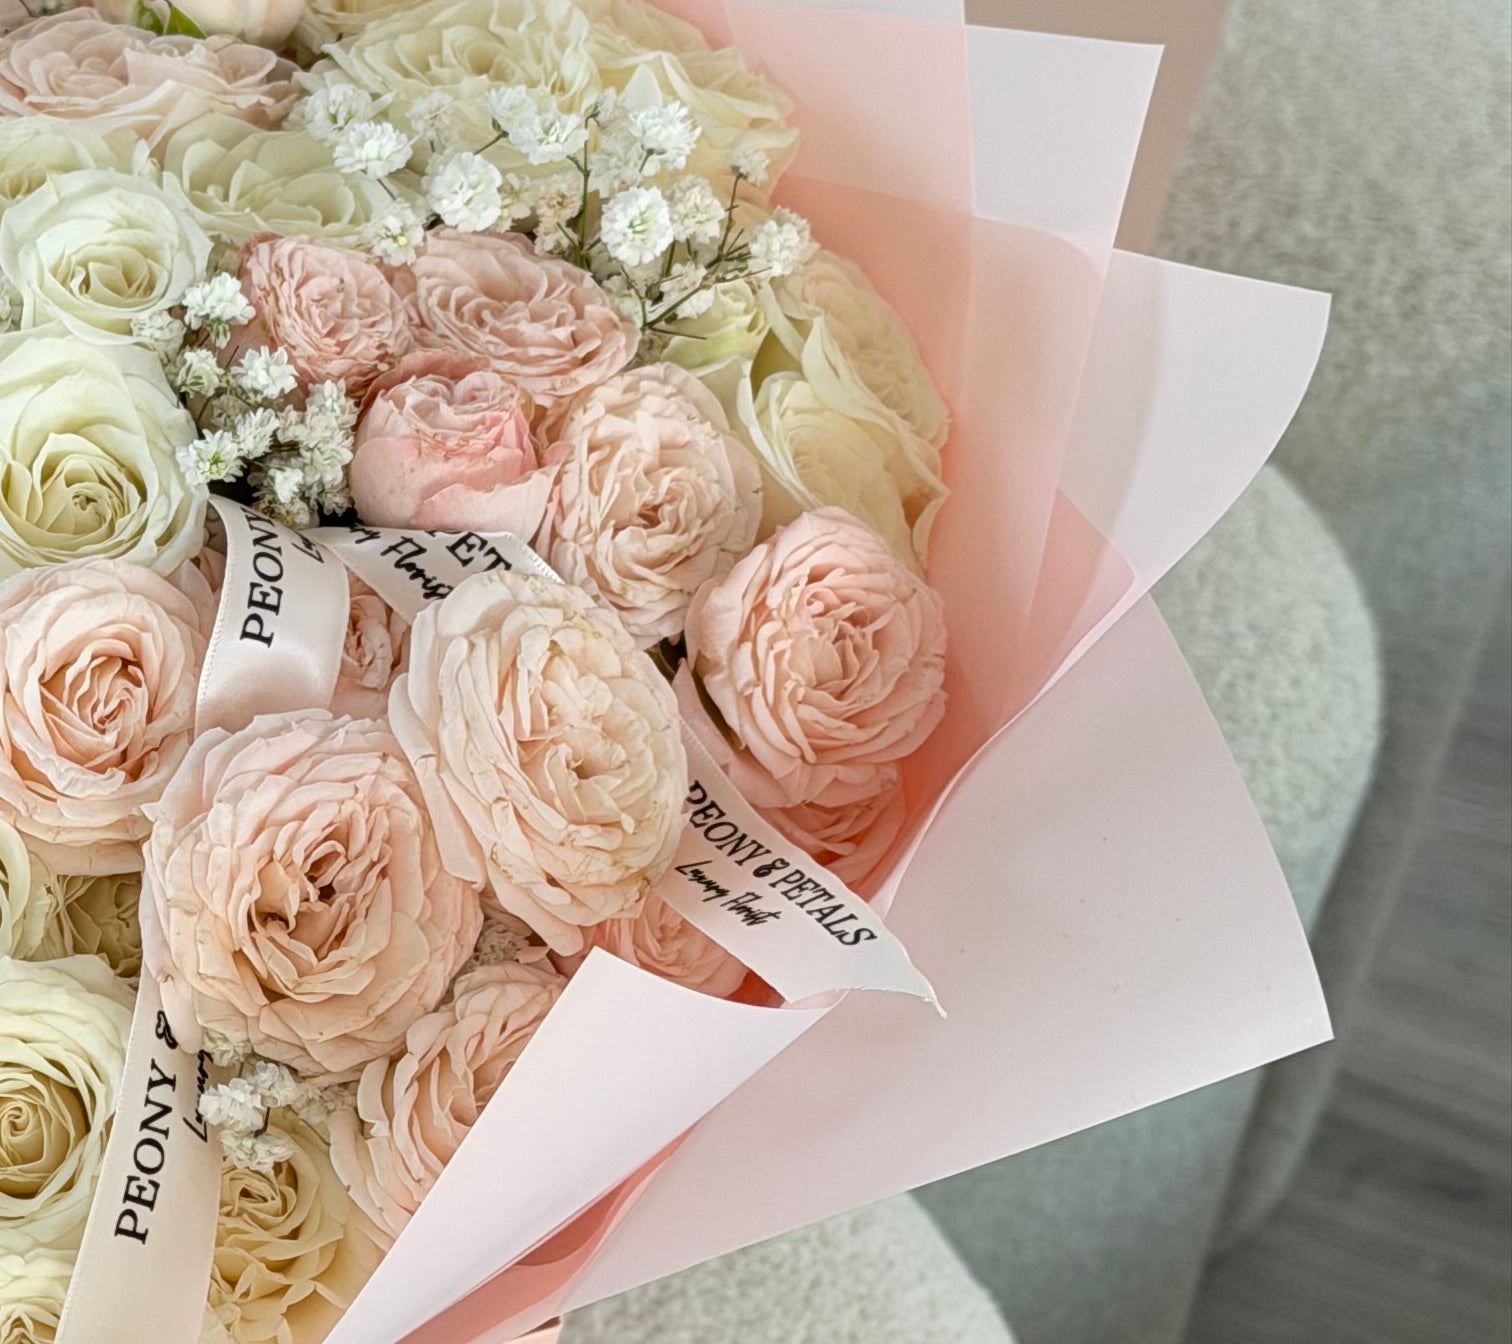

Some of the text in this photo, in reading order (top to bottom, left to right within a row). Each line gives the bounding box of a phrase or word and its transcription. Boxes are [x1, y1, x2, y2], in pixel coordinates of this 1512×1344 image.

[240, 506, 284, 649] PEONY
[685, 780, 878, 947] PEONY & PETALS
[114, 1058, 177, 1245] PEONY
